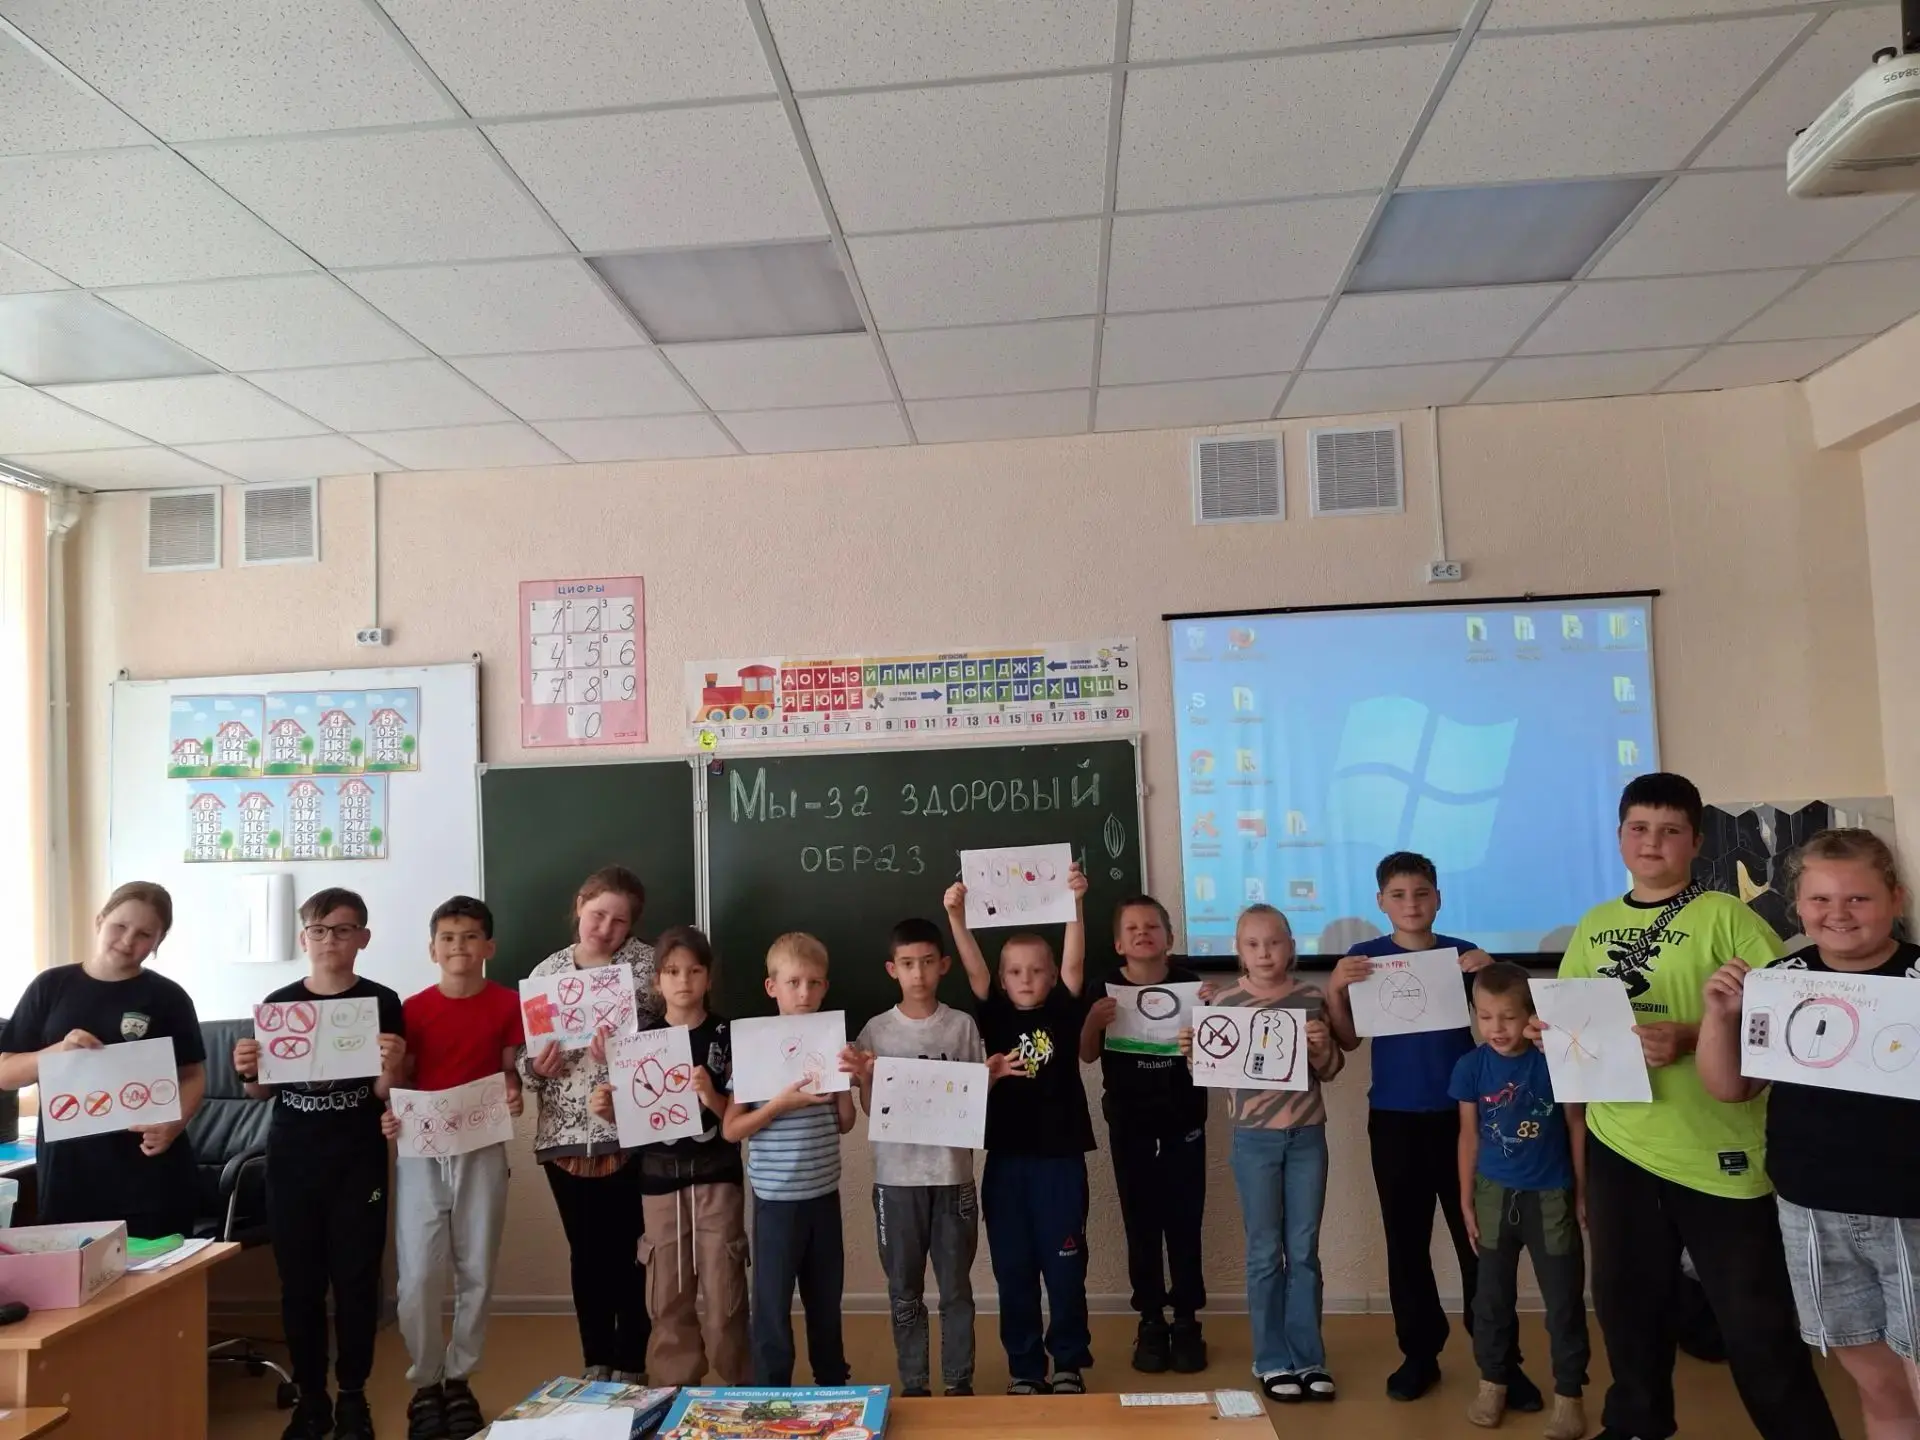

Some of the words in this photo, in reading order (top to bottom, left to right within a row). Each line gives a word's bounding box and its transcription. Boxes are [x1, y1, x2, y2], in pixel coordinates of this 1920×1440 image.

[558, 585, 605, 595] ЦИФРЫ
[553, 607, 563, 633] 1
[585, 606, 600, 632] 2
[620, 605, 635, 630] 3
[551, 642, 564, 668] 4
[585, 641, 600, 666] 5
[620, 640, 635, 665] 6
[551, 678, 564, 703] 7
[584, 676, 600, 702] 8
[621, 675, 635, 700] 9
[585, 712, 601, 738] 0
[721, 728, 726, 737] 1
[740, 727, 746, 737] 2
[761, 726, 768, 736] 3
[782, 724, 789, 734] 4
[803, 724, 809, 734] 5
[824, 723, 830, 733] 6
[845, 722, 851, 732] 7
[865, 722, 872, 731] 8
[886, 721, 892, 730] 9
[904, 720, 917, 729] 10
[925, 719, 936, 728] 11
[946, 718, 958, 727] 12
[967, 717, 979, 726] 13
[988, 715, 1000, 725] 14
[1009, 714, 1021, 724] 15
[1030, 713, 1043, 723] 16
[1052, 712, 1064, 722] 17
[1073, 711, 1086, 721] 18
[1095, 710, 1108, 720] 19
[1116, 709, 1130, 719] 20
[1517, 1121, 1539, 1138] 83
